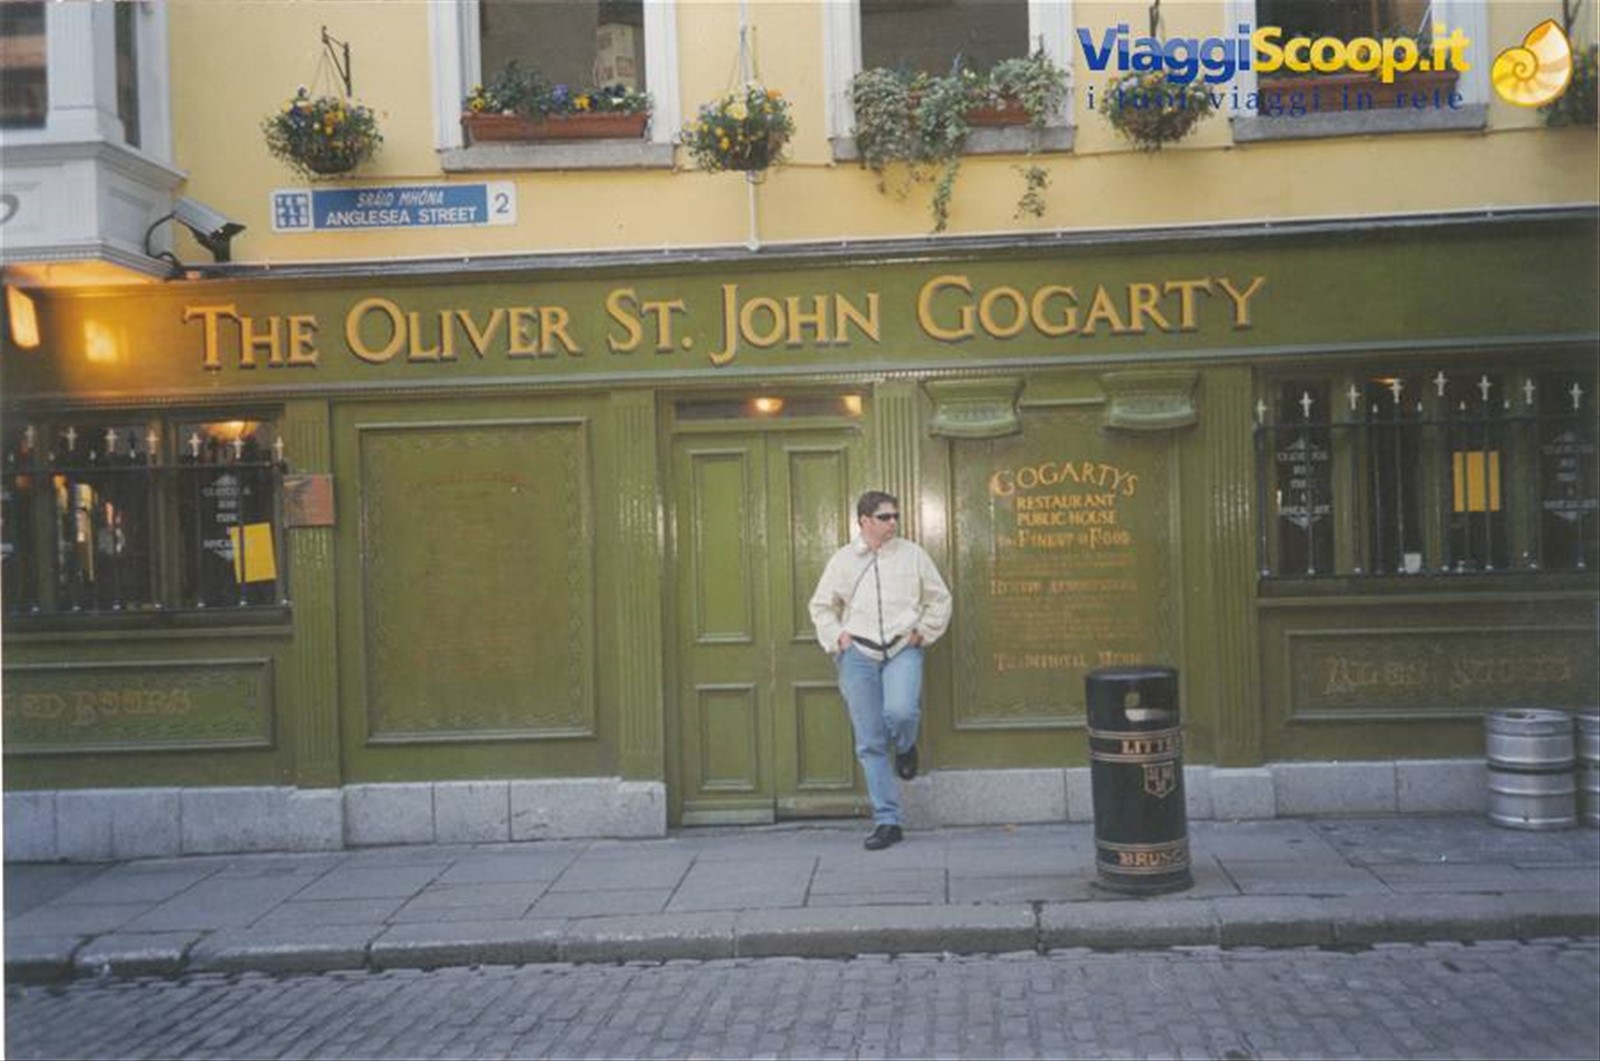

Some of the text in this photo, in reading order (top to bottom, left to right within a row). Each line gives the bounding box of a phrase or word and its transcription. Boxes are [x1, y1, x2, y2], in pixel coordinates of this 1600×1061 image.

[495, 192, 510, 214] 2
[326, 205, 478, 226] ANGLESEA STREET
[184, 273, 1266, 371] THE OLIVER ST. JOHN GOGARTY
[1016, 493, 1116, 511] RESTAURANT
[1016, 508, 1117, 527] PUBLIC HOUSE
